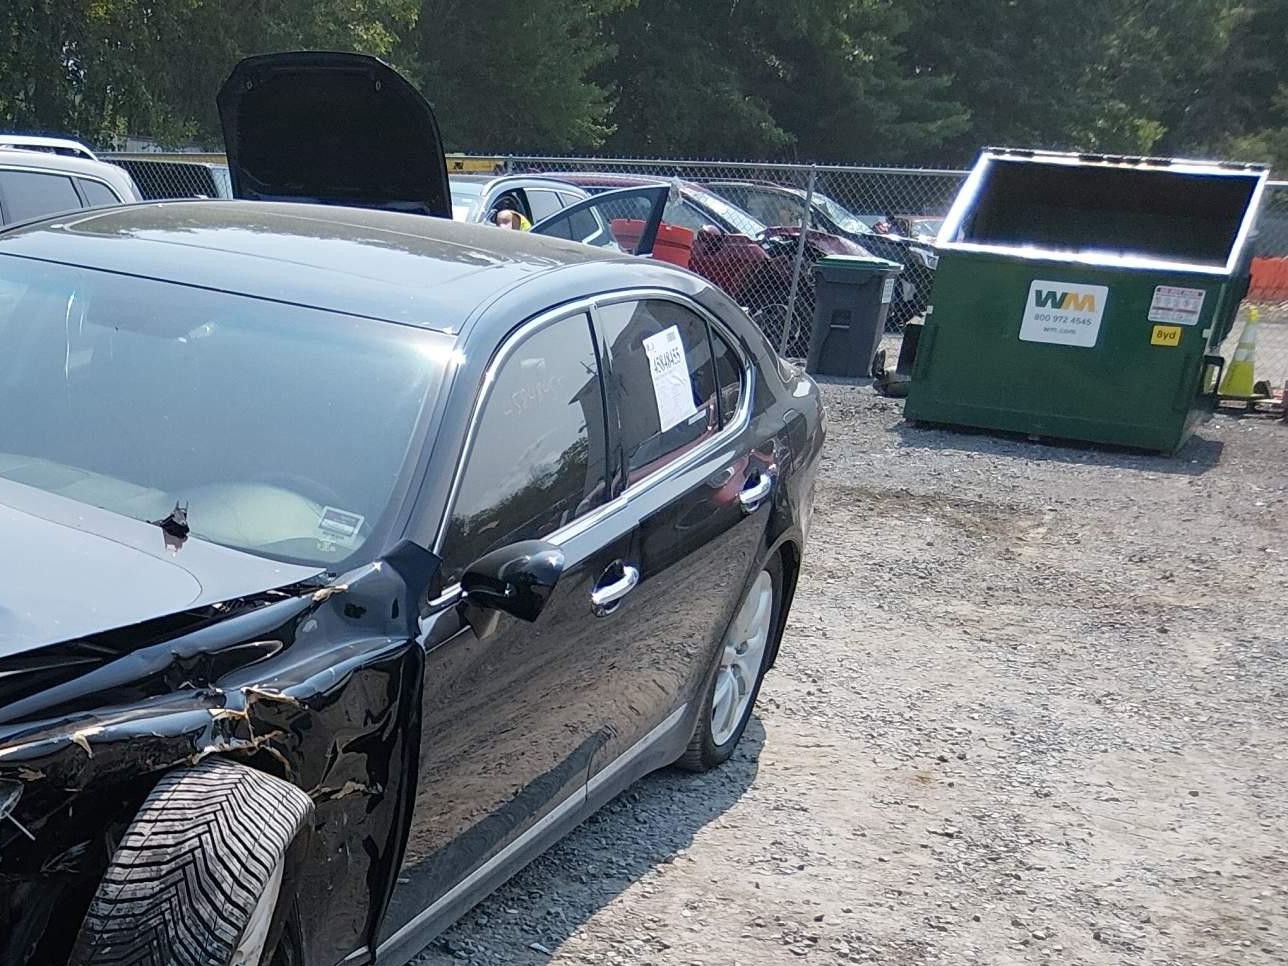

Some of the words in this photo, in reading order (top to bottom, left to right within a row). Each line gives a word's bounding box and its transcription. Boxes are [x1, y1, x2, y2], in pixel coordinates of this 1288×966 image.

[1034, 289, 1096, 313] WM
[1033, 313, 1051, 322] 800
[1052, 314, 1069, 324] 972
